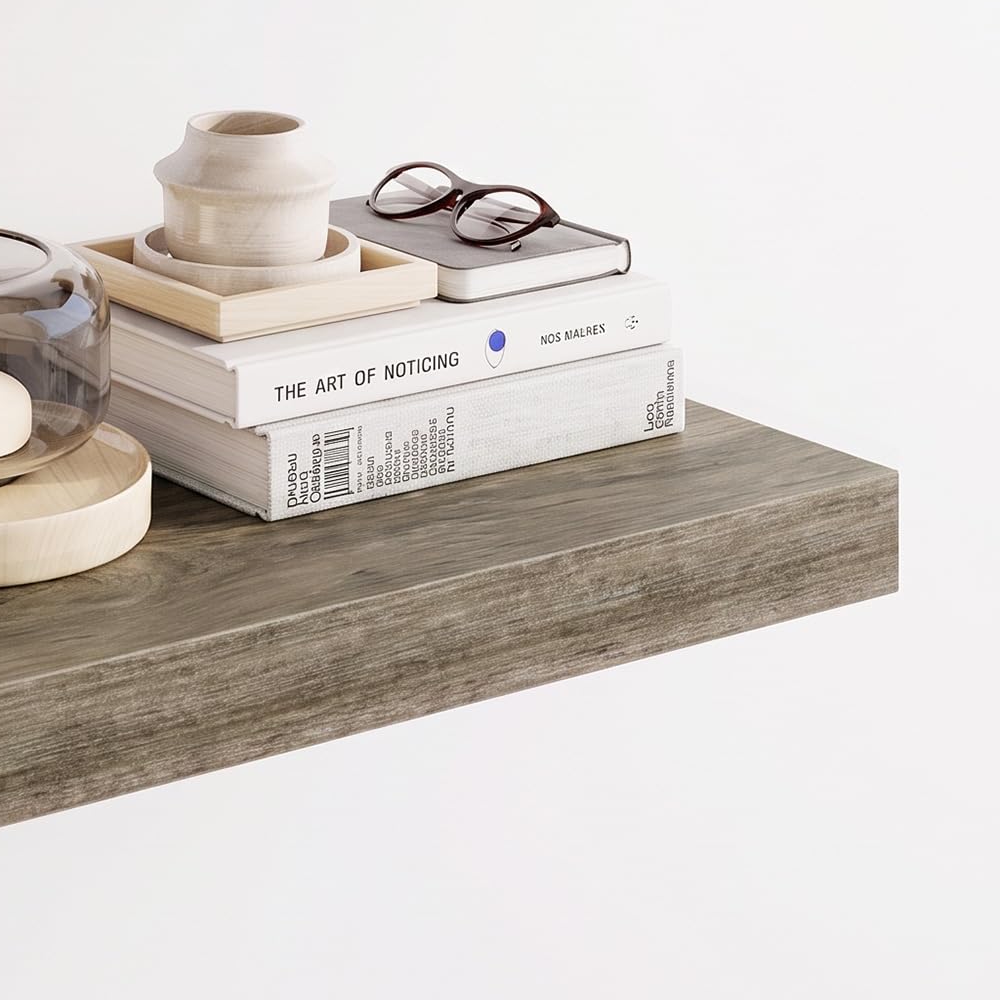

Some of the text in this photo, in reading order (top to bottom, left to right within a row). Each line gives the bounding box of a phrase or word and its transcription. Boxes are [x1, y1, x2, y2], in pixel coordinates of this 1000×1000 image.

[274, 351, 459, 402] THE ART OF NOTICING
